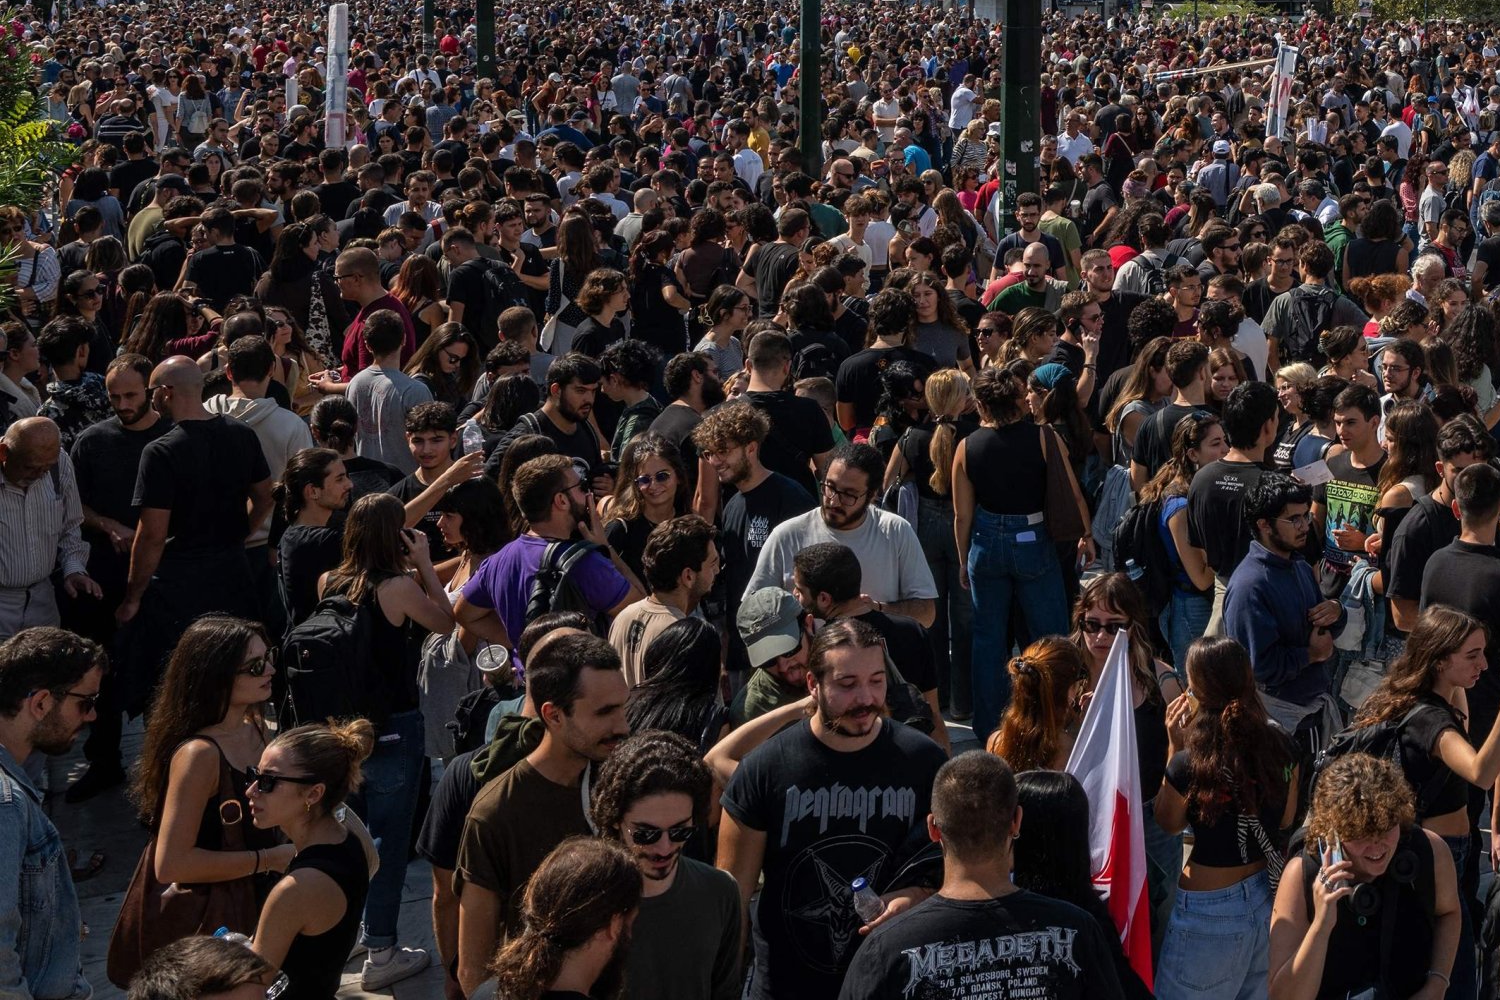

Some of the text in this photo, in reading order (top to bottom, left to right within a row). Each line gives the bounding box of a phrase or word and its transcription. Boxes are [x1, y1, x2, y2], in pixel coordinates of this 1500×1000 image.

[901, 926, 1082, 999] MEGADETH
[940, 979, 955, 989] 5/6
[1016, 965, 1049, 978] SWEDEN
[951, 987, 966, 997] 7/6
[1008, 977, 1038, 989] POLAND
[961, 987, 1047, 1000] BUDAPEST, HUNGARY
